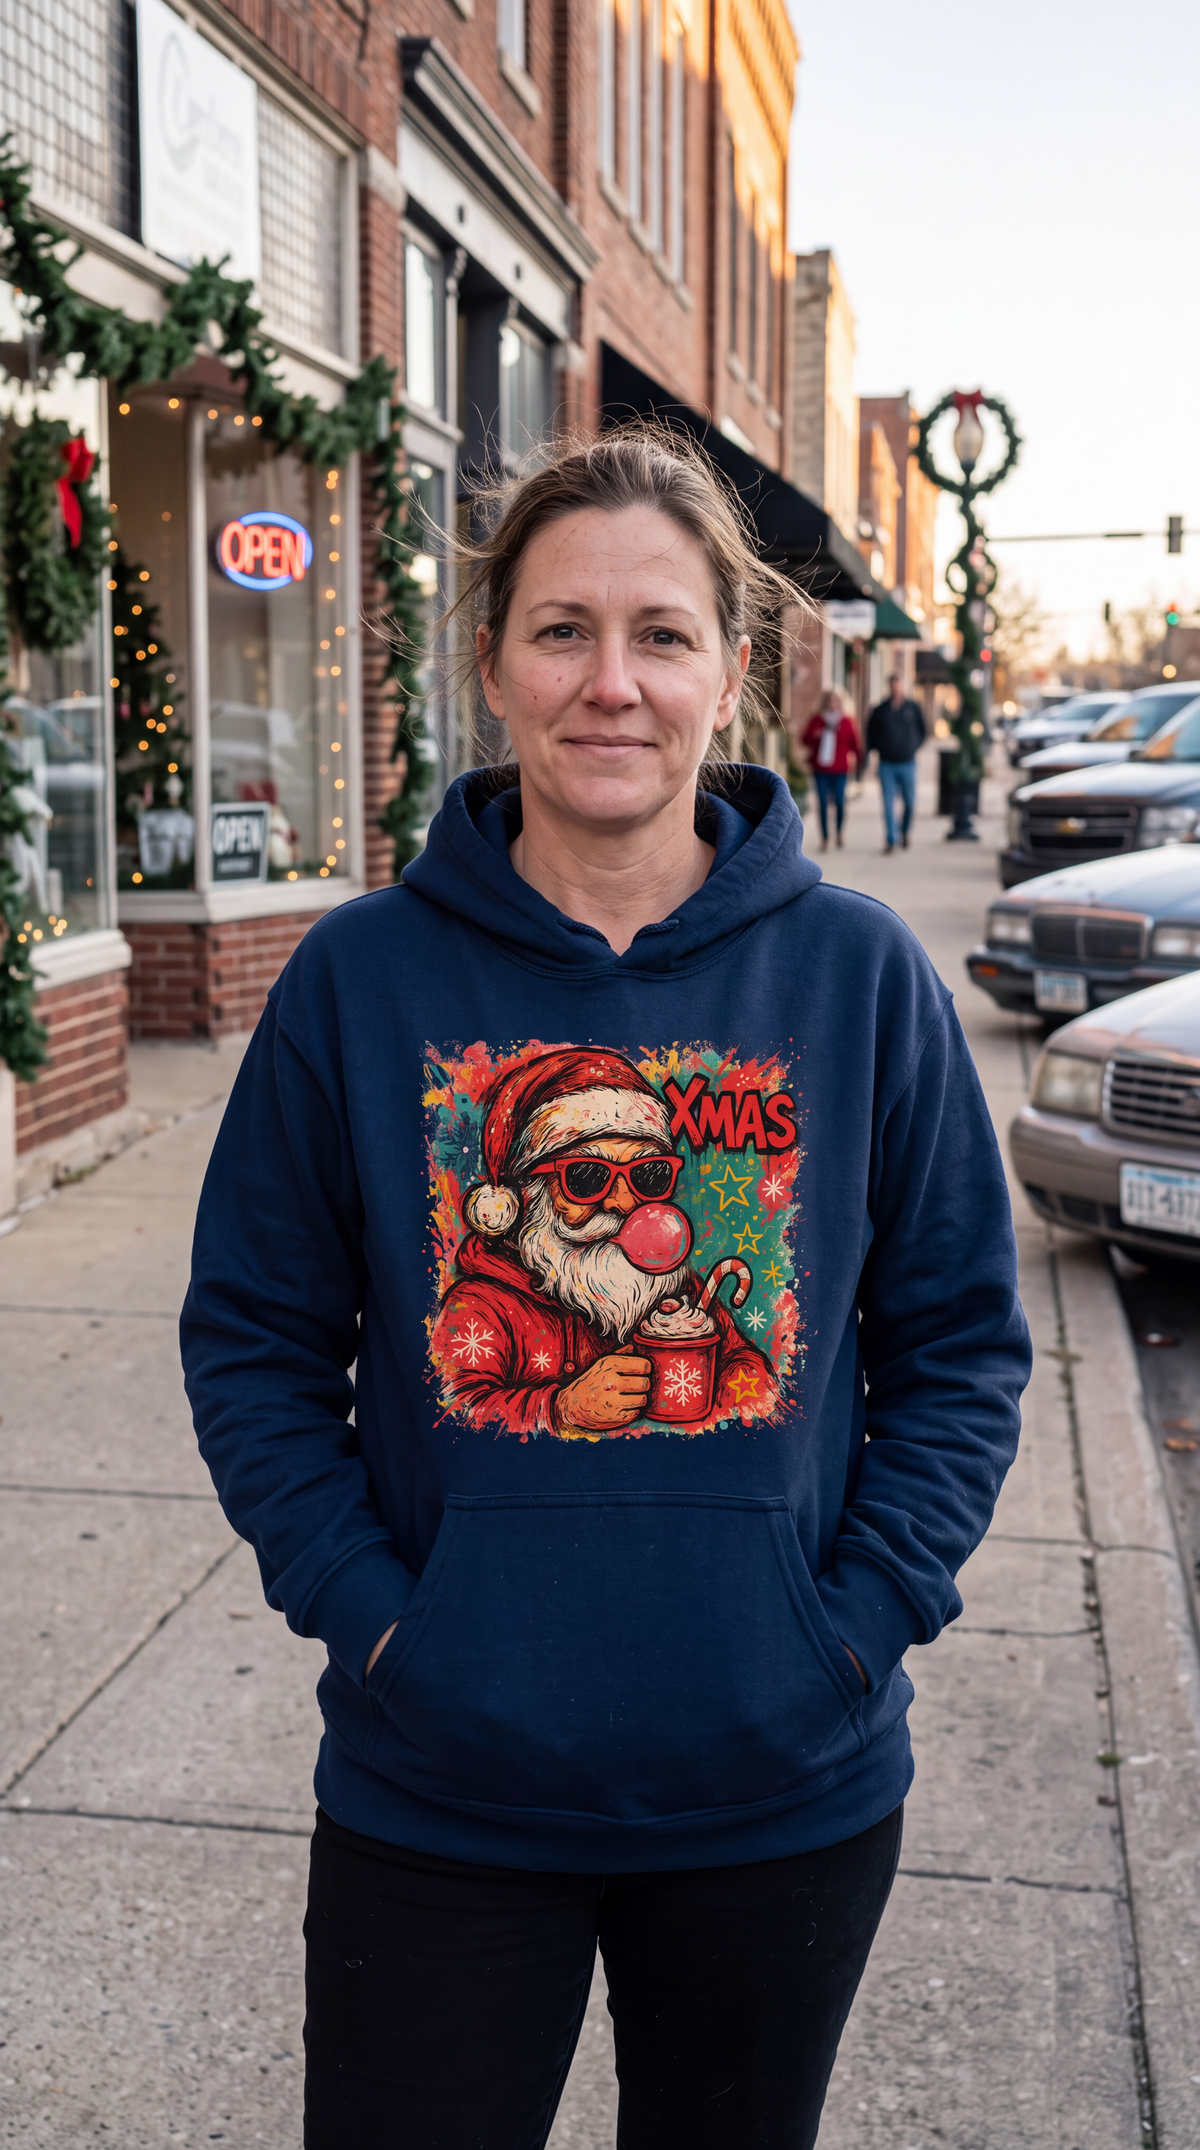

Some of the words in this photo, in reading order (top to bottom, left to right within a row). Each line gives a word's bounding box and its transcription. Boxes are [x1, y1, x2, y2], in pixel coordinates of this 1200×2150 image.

[221, 520, 306, 581] OPEN
[213, 816, 261, 855] OPEN
[662, 1074, 797, 1154] XMAS
